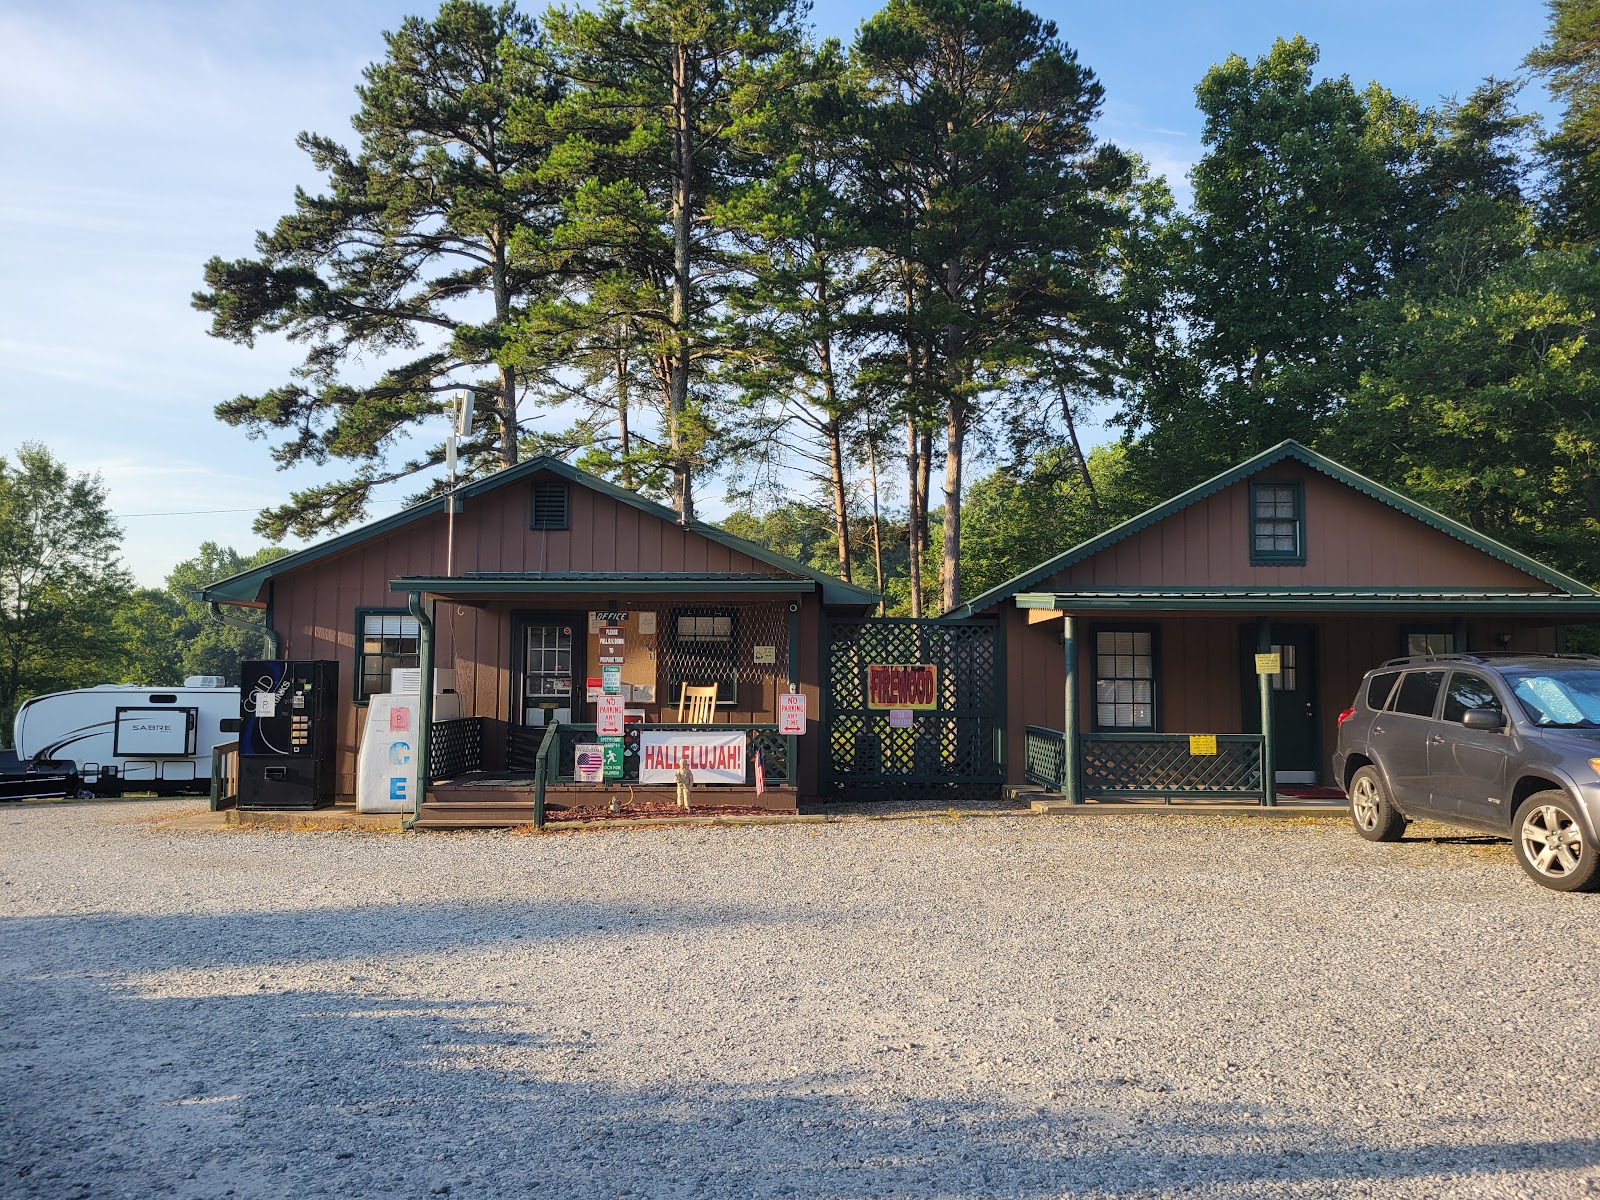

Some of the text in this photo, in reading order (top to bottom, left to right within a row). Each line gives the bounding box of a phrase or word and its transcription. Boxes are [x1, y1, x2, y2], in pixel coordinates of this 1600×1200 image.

[596, 612, 627, 620] OFFICE
[870, 670, 933, 704] FIREWOOD
[645, 745, 740, 770] HALLELUJAH!
